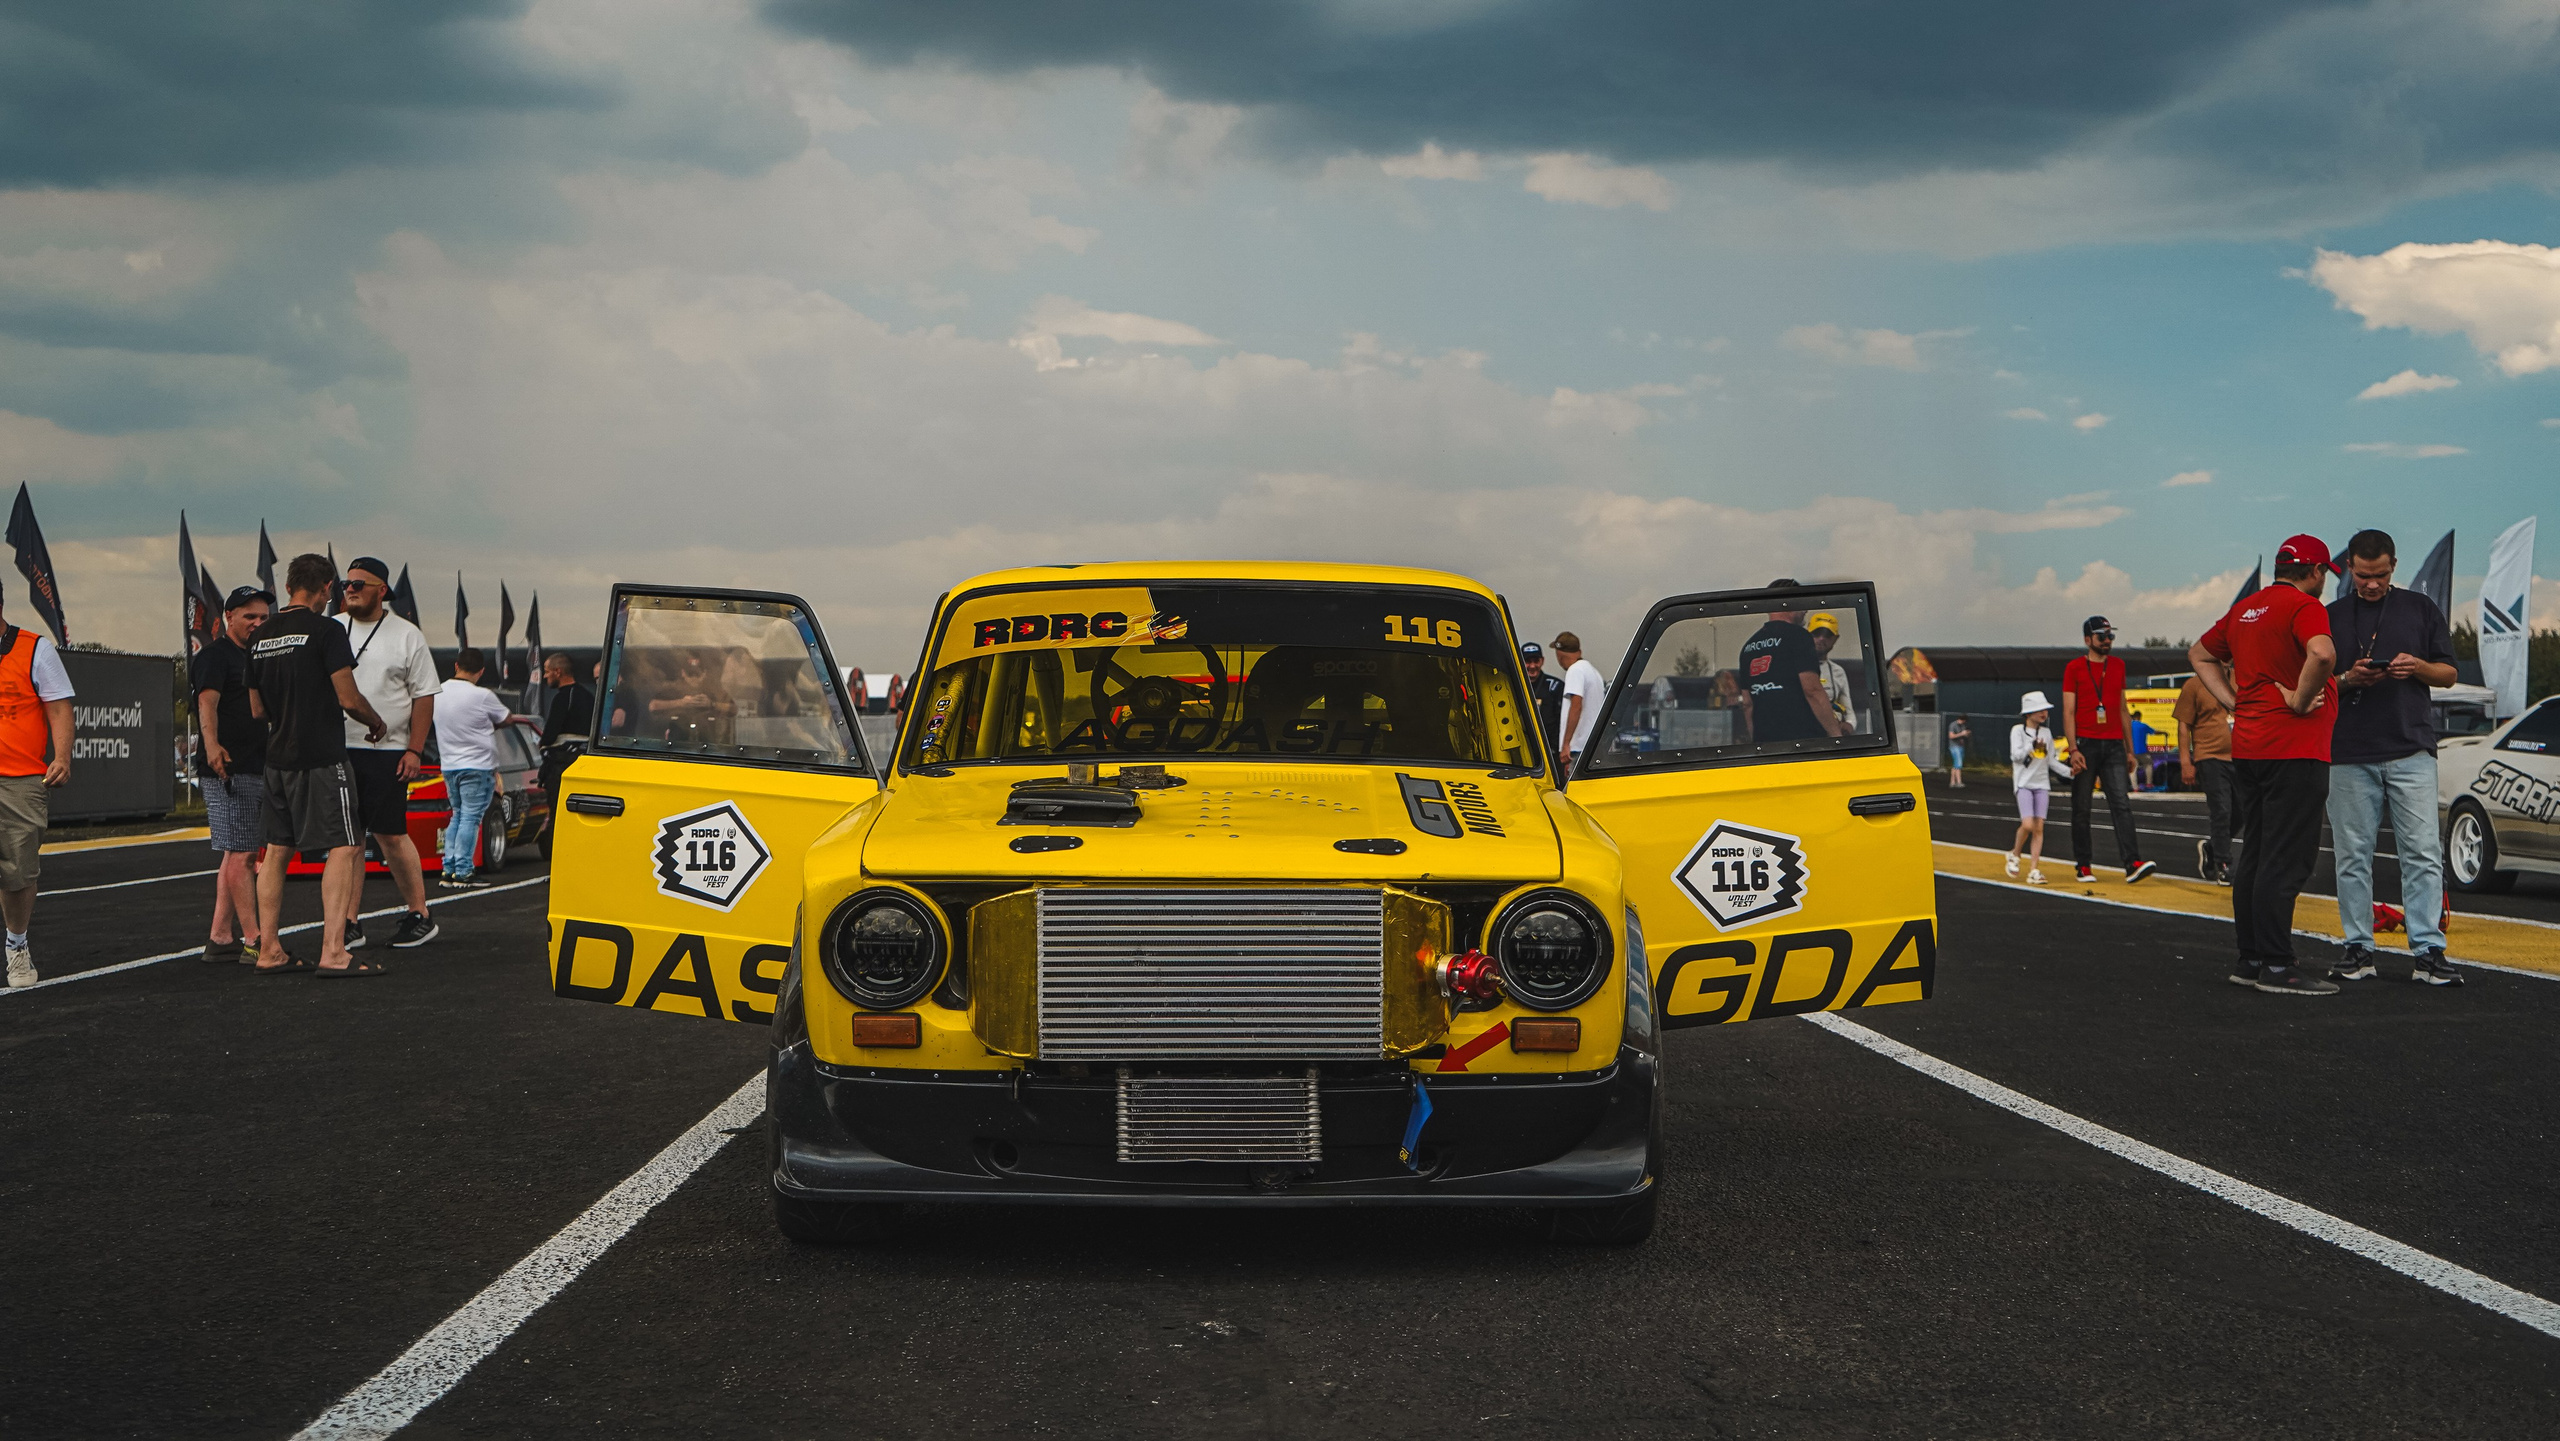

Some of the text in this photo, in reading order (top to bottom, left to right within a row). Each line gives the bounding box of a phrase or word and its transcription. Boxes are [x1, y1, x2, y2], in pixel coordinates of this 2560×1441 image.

[260, 638, 282, 649] MOTOR
[283, 636, 305, 645] SPORT
[973, 611, 1128, 648] RDRC
[1383, 614, 1462, 648] 116
[1313, 660, 1378, 677] sparco
[72, 738, 130, 759] ОНТРОЛЬ
[1050, 717, 1381, 754] AGDASH
[1445, 781, 1507, 838] MOTORS
[691, 828, 720, 838] RDRC
[685, 840, 736, 871] 116
[1711, 847, 1745, 858] RDRC
[1711, 860, 1770, 893] 116
